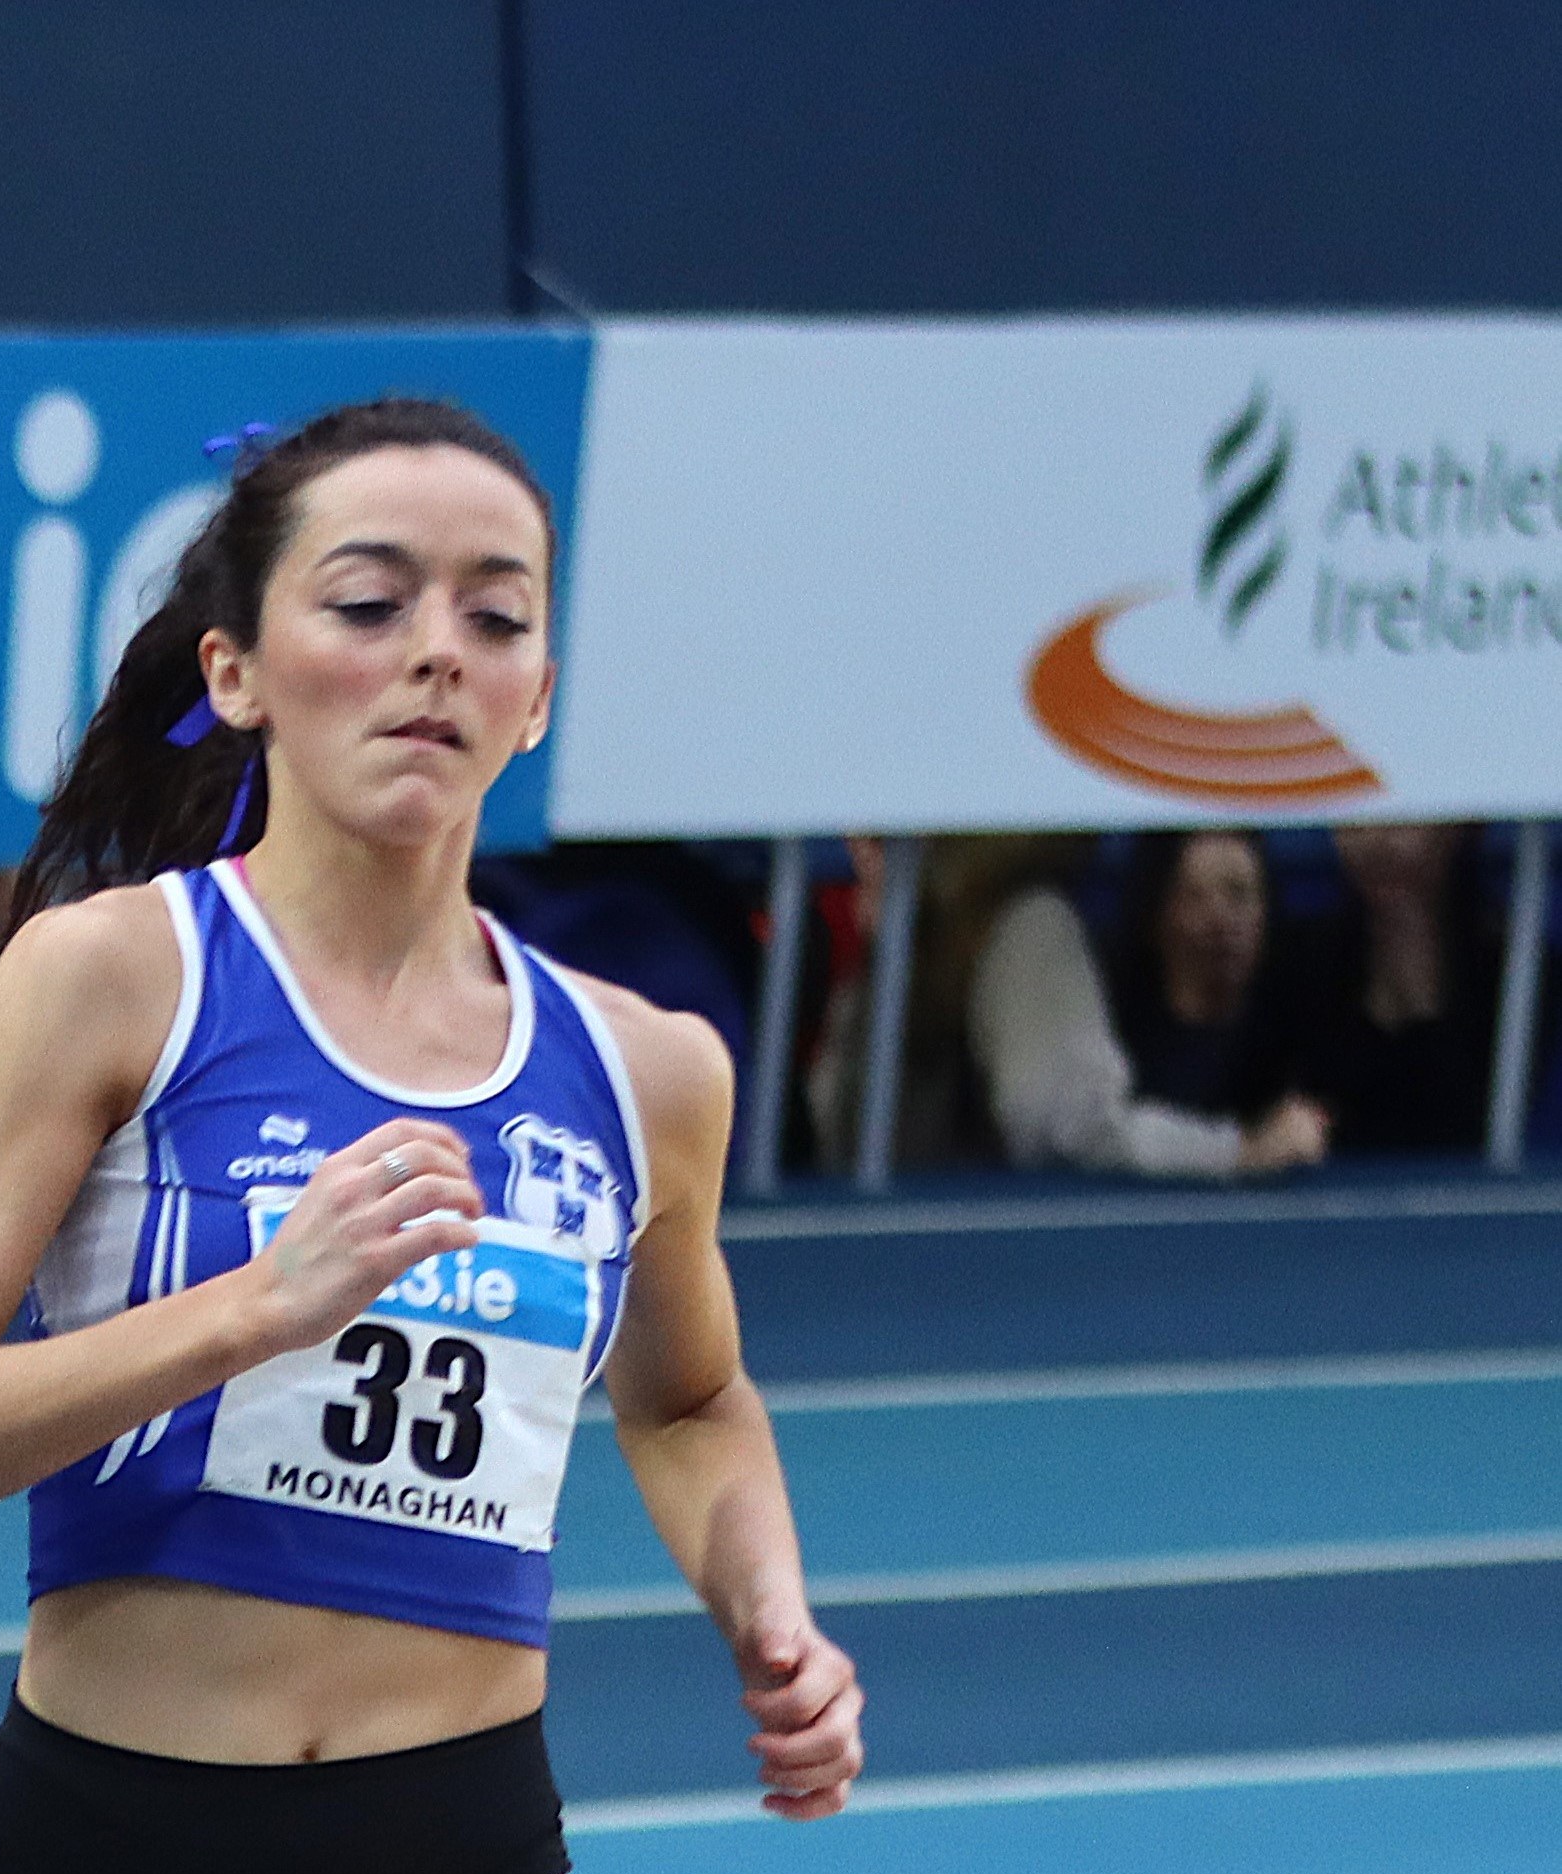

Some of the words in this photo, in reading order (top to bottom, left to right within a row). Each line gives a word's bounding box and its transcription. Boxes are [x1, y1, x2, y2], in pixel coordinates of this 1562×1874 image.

[1320, 440, 1562, 543] Athle
[322, 1322, 486, 1481] 33
[267, 1461, 511, 1532] MONAGHAN
